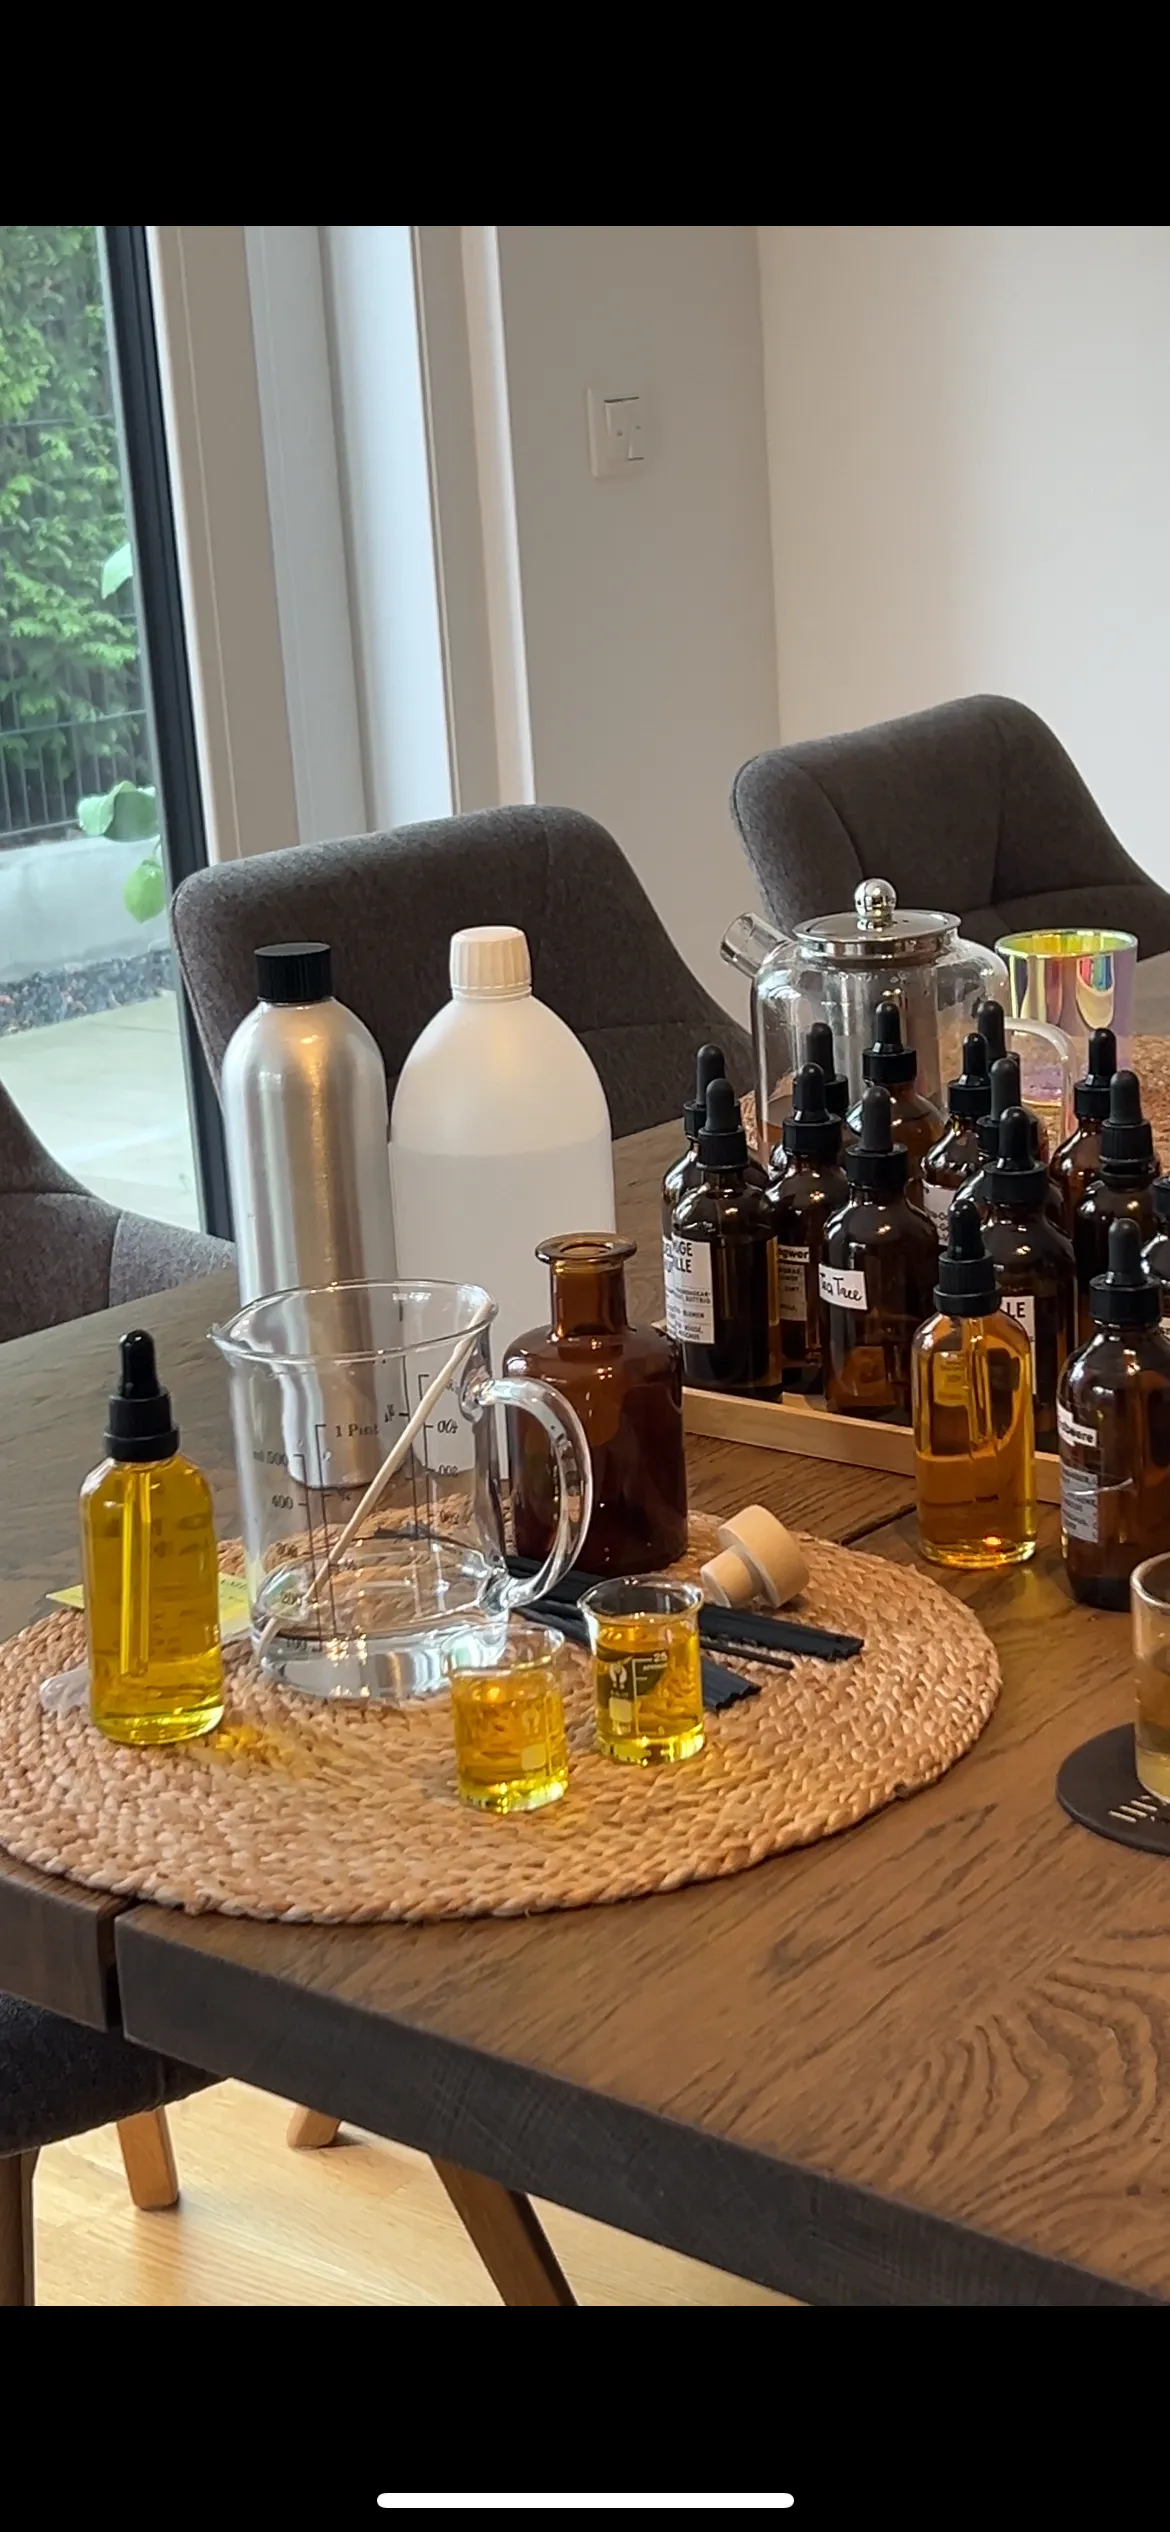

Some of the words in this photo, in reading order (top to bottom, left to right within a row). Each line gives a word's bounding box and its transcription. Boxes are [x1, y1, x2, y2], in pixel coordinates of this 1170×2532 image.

[833, 1277, 862, 1301] Tree
[335, 1425, 342, 1437] 1
[348, 1423, 379, 1437] Pint
[271, 1494, 294, 1510] 400
